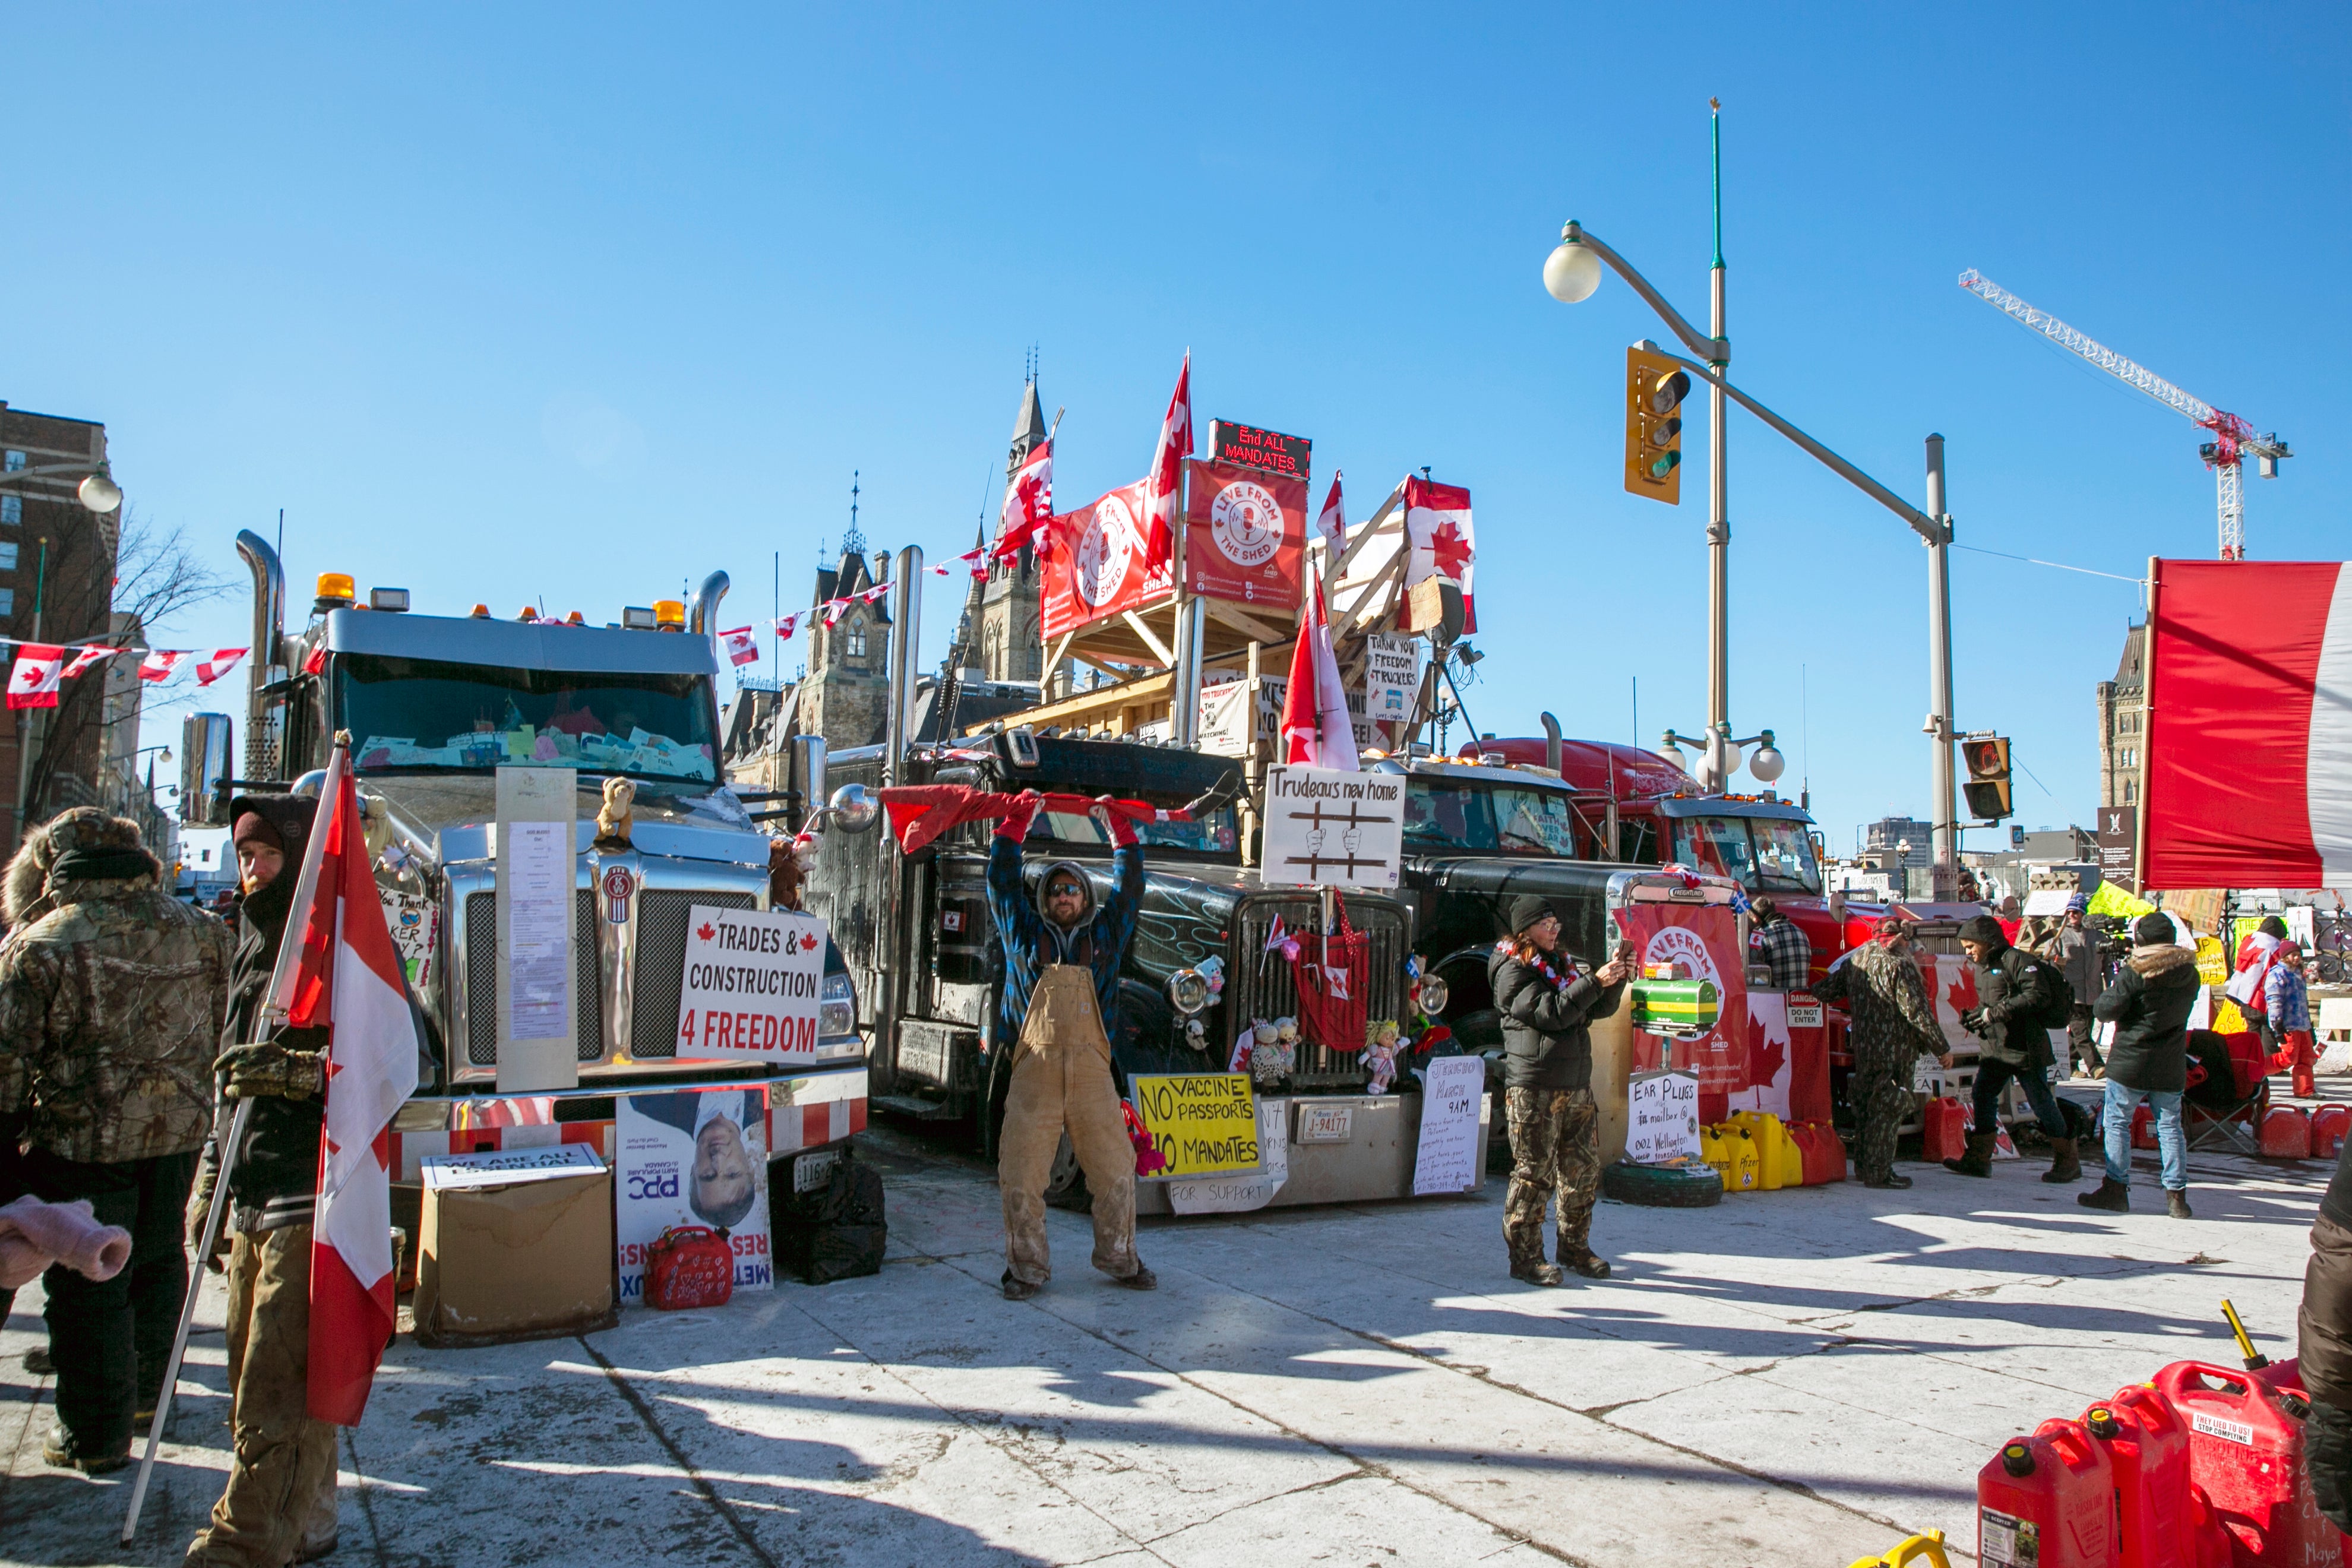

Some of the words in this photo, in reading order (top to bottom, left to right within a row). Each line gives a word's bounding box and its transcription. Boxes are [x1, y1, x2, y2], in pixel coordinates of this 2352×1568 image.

[1238, 429, 1261, 447] End
[1263, 434, 1288, 453] ALL
[1216, 486, 1243, 511] LIVE
[1247, 486, 1279, 521] FROM
[1221, 536, 1239, 557] THE
[1241, 543, 1271, 560] SHED
[1084, 578, 1098, 599] THE
[1101, 567, 1122, 598] SHED
[1370, 636, 1396, 652] THANK
[1399, 640, 1415, 655] YOU
[1374, 653, 1412, 670] FREEDOM
[1371, 670, 1416, 685] TRUCKERS
[1269, 767, 1339, 798] Trudeau's
[1343, 783, 1365, 799] new
[1367, 779, 1398, 801] home
[612, 885, 625, 894] W
[615, 877, 622, 886] K
[398, 893, 429, 911] Thank
[718, 923, 780, 954] TRADES
[786, 930, 798, 956] &
[690, 963, 817, 998] CONSTRUCTION
[681, 1009, 695, 1046] 4
[704, 1010, 816, 1053] FREEDOM
[1431, 1059, 1475, 1079] JERICHO
[1436, 1080, 1465, 1099] MARCH
[1635, 1082, 1655, 1102] EAR
[1662, 1079, 1693, 1101] PLUGS
[1139, 1085, 1173, 1123] NO
[1167, 1077, 1245, 1098] VACCINE
[1449, 1099, 1469, 1114] 9AM
[1177, 1099, 1254, 1121] PASSPORTS
[1651, 1107, 1677, 1123] mailbox
[1680, 1105, 1687, 1120] @
[1308, 1118, 1347, 1131] J-94177
[1184, 1136, 1259, 1164] MANDATES
[1654, 1133, 1688, 1152] Wellington
[489, 1155, 533, 1165] ARE
[539, 1152, 578, 1160] ALL
[1740, 1155, 1759, 1173] Pfizer
[803, 1164, 820, 1183] 116
[627, 1174, 679, 1200] PPC
[1171, 1186, 1198, 1204] FOR
[1209, 1185, 1263, 1202] SUPPORT
[2196, 1415, 2212, 1425] THEY
[2213, 1420, 2227, 1430] LIED
[2228, 1423, 2237, 1433] TO
[2239, 1426, 2250, 1436] US!
[2198, 1424, 2212, 1433] STOP
[2214, 1428, 2247, 1443] COMPLYING
[1991, 1516, 2012, 1526] SCEPTER
